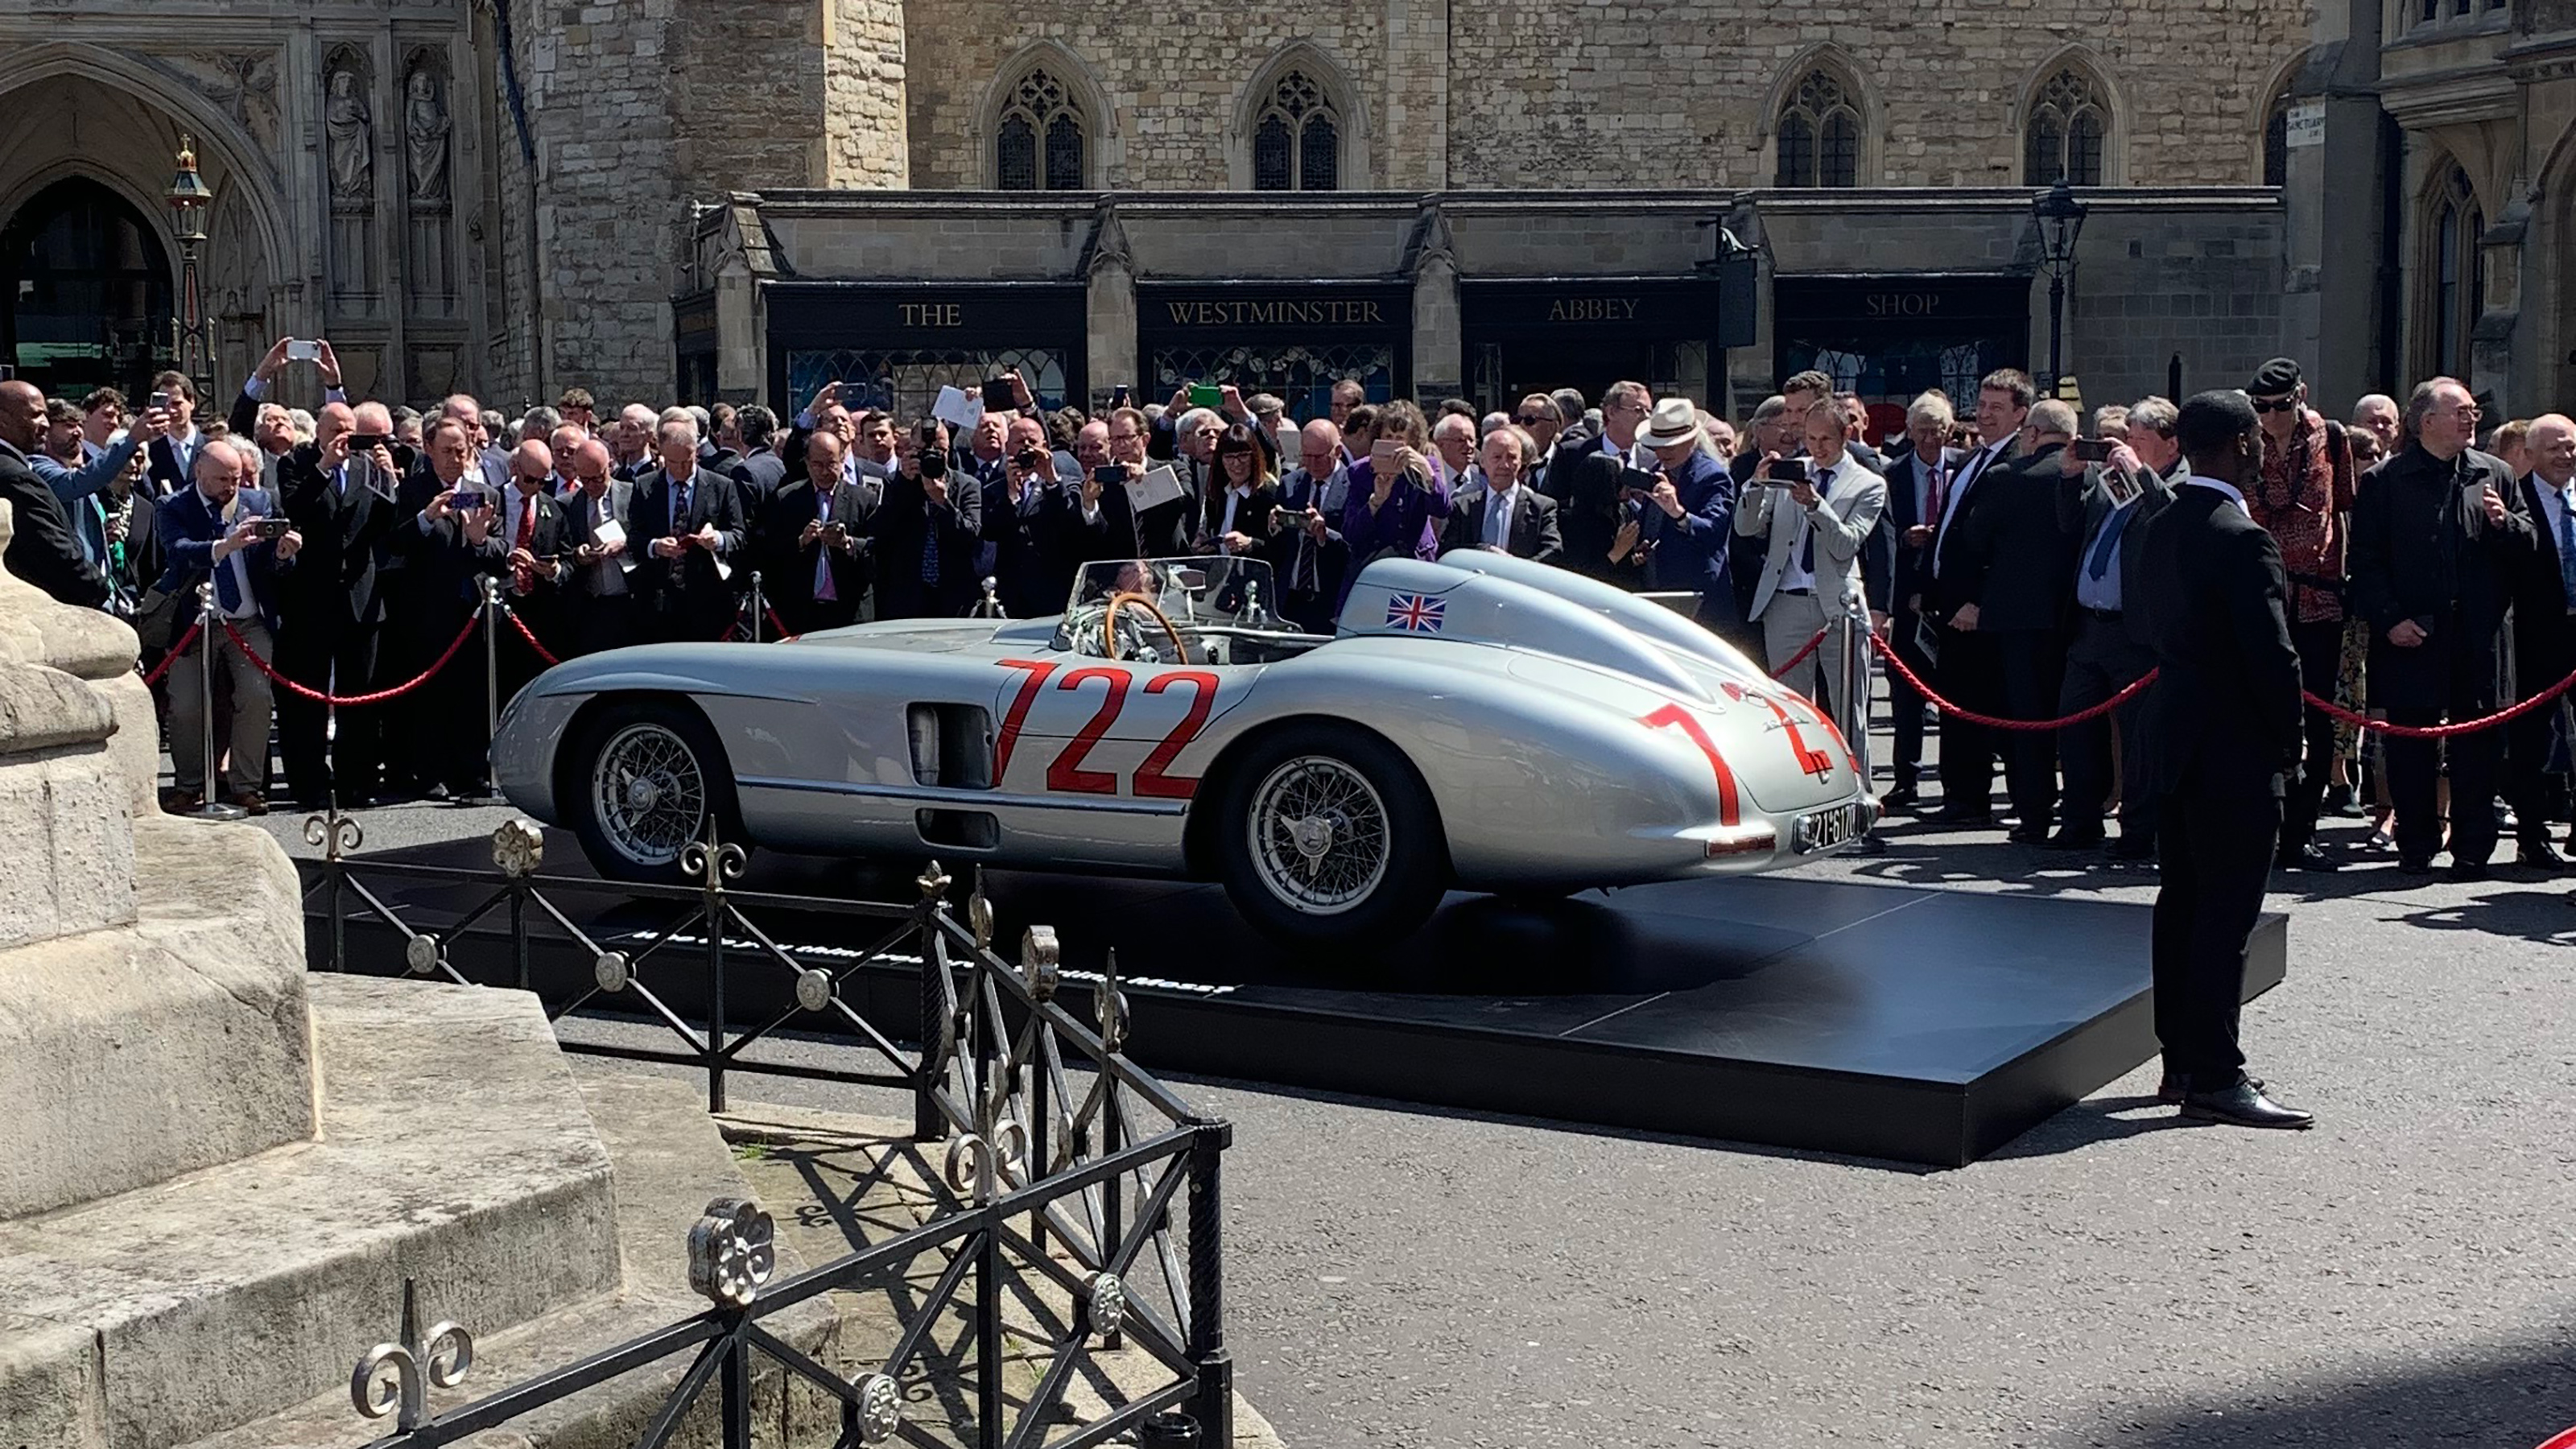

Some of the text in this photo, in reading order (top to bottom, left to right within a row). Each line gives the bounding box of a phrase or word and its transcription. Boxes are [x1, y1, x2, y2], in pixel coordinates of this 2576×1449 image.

[898, 294, 1939, 326] THE WESTMINSTER ABBEY SHOP
[992, 658, 1220, 799] 722
